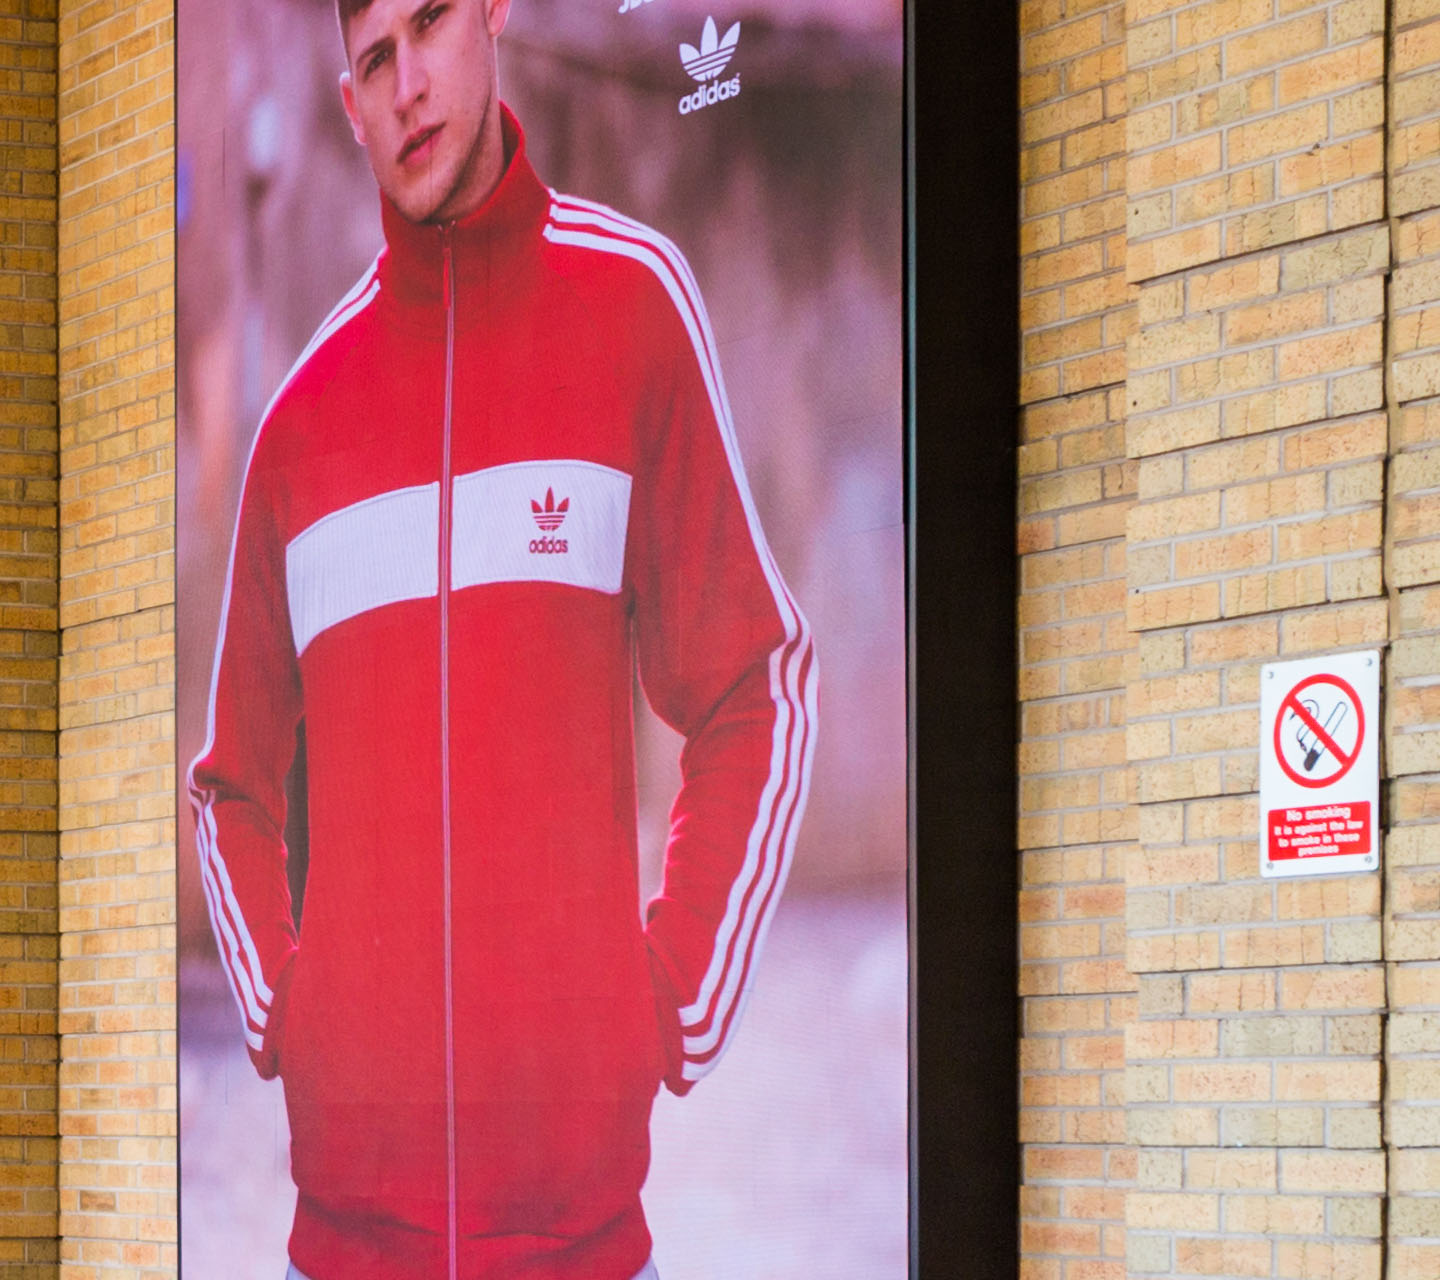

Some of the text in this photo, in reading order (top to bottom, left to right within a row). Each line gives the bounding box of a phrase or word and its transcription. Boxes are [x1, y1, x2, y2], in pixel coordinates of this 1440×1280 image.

[678, 76, 741, 115] adidas
[528, 536, 569, 554] adidas
[1286, 806, 1351, 821] No smoking
